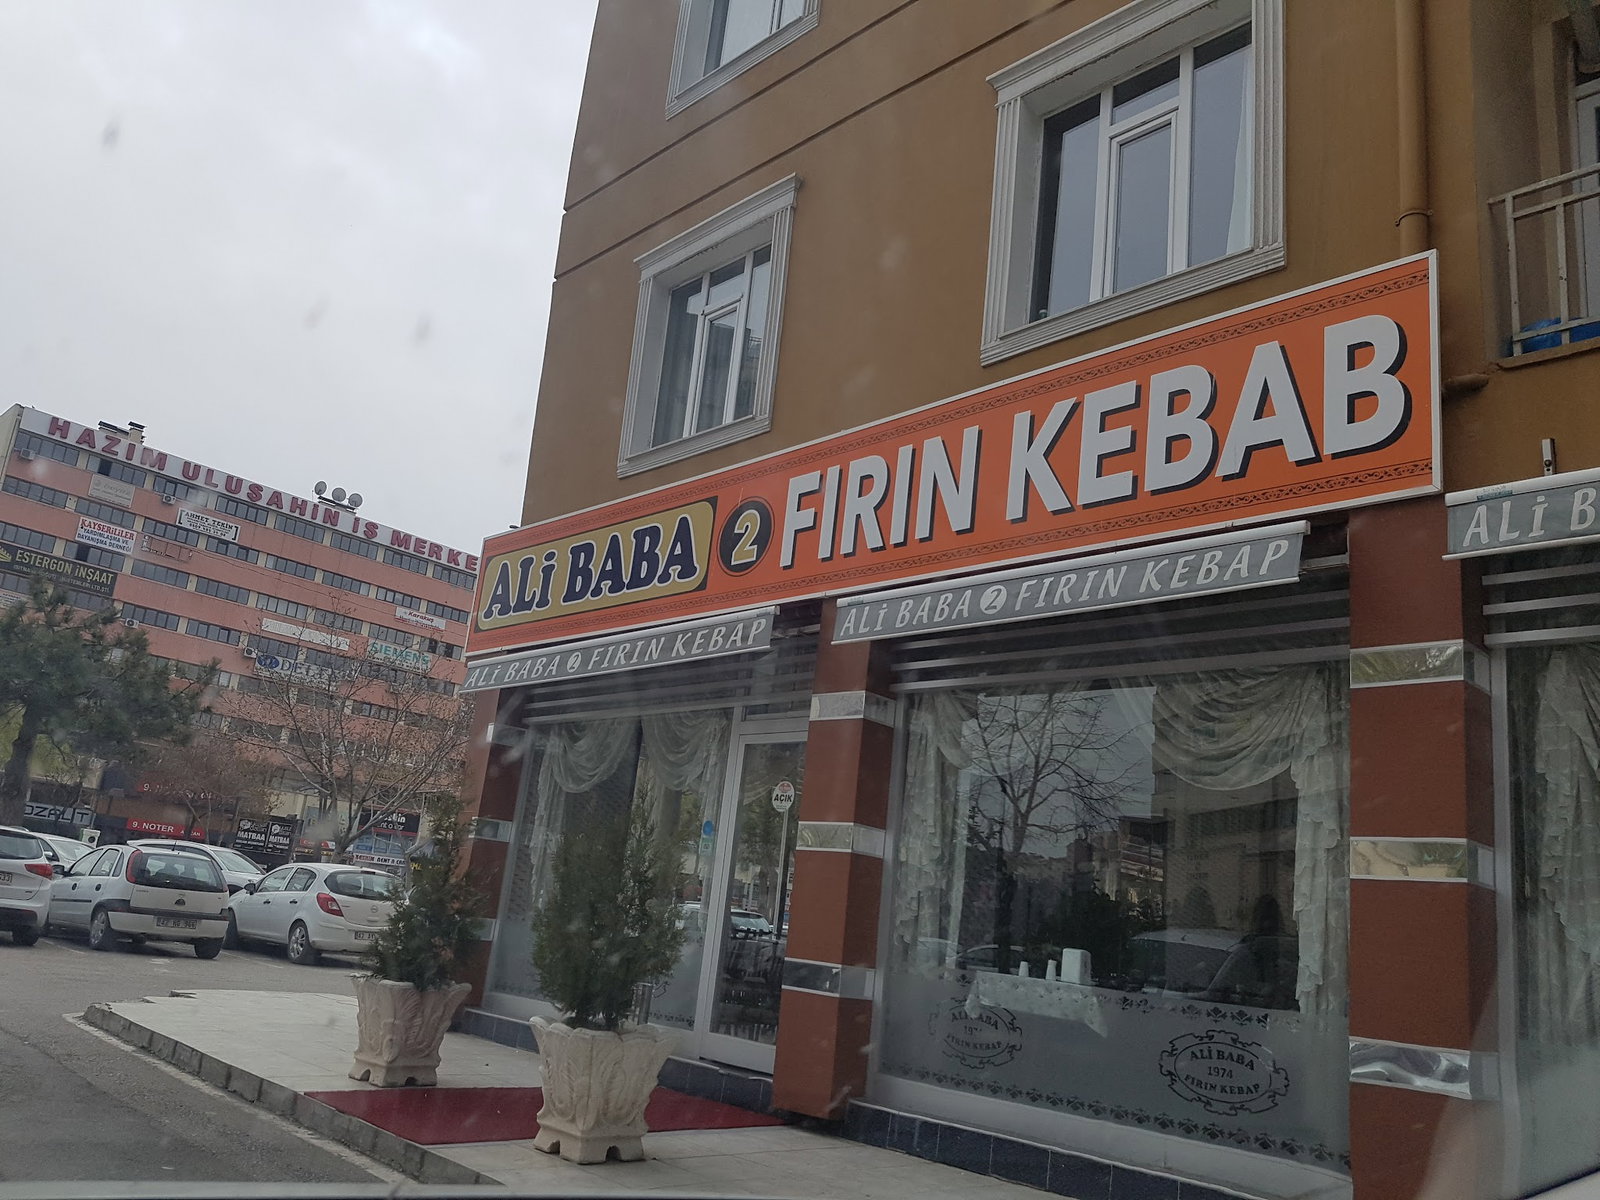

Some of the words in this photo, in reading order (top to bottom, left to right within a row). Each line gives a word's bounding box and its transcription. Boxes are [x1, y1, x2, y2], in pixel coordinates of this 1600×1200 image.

[48, 416, 168, 471] HAZIM
[779, 426, 981, 570] FIRIN
[1006, 314, 1412, 522] KEBAB
[185, 512, 209, 523] AHMET
[15, 549, 73, 575] ESTERGON
[561, 513, 700, 604] BABA
[730, 509, 762, 566] 2
[895, 589, 971, 629] BABA
[984, 586, 1006, 613] 2
[1014, 566, 1126, 611] FIRIN
[1139, 540, 1289, 594] KEBAP
[371, 642, 430, 665] SIEMENS
[503, 655, 561, 682] BABA
[588, 637, 666, 671] FIRIN
[671, 618, 767, 657] KEBAP
[774, 793, 793, 804] AÇIK
[142, 822, 174, 833] NOTER
[237, 830, 265, 841] MATBAA
[269, 835, 290, 844] MATBAA
[974, 1040, 1002, 1050] KEBAP
[1217, 1049, 1255, 1071] BABA
[1207, 1066, 1233, 1079] 1974
[1184, 1074, 1217, 1092] FIRIN
[1220, 1083, 1260, 1095] KEBAP
